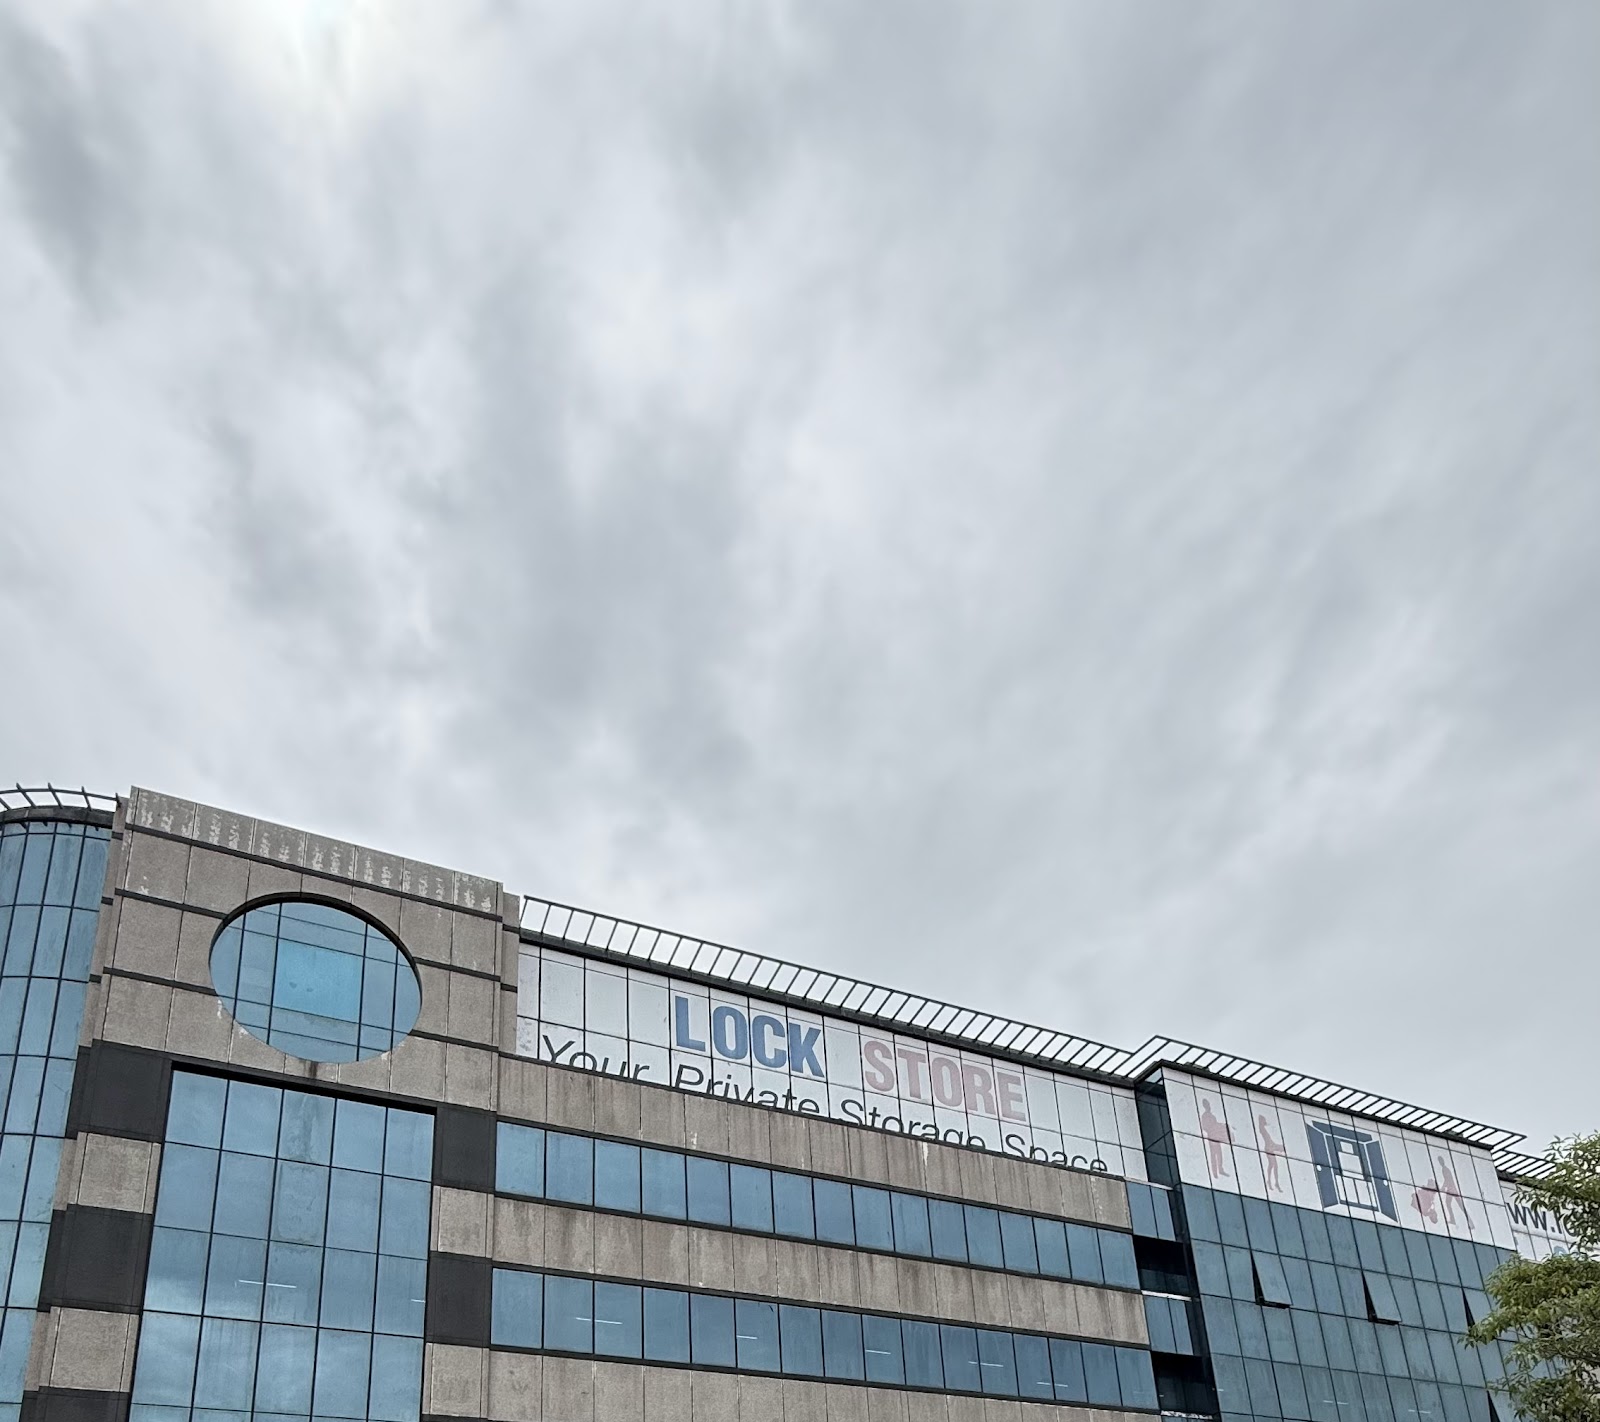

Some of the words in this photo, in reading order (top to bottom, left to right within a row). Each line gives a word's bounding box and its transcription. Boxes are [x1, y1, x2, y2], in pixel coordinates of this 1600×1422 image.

[542, 1034, 650, 1080] Your
[674, 1063, 820, 1114] Private
[674, 995, 825, 1078] LOCK
[863, 1040, 1027, 1122] STORE
